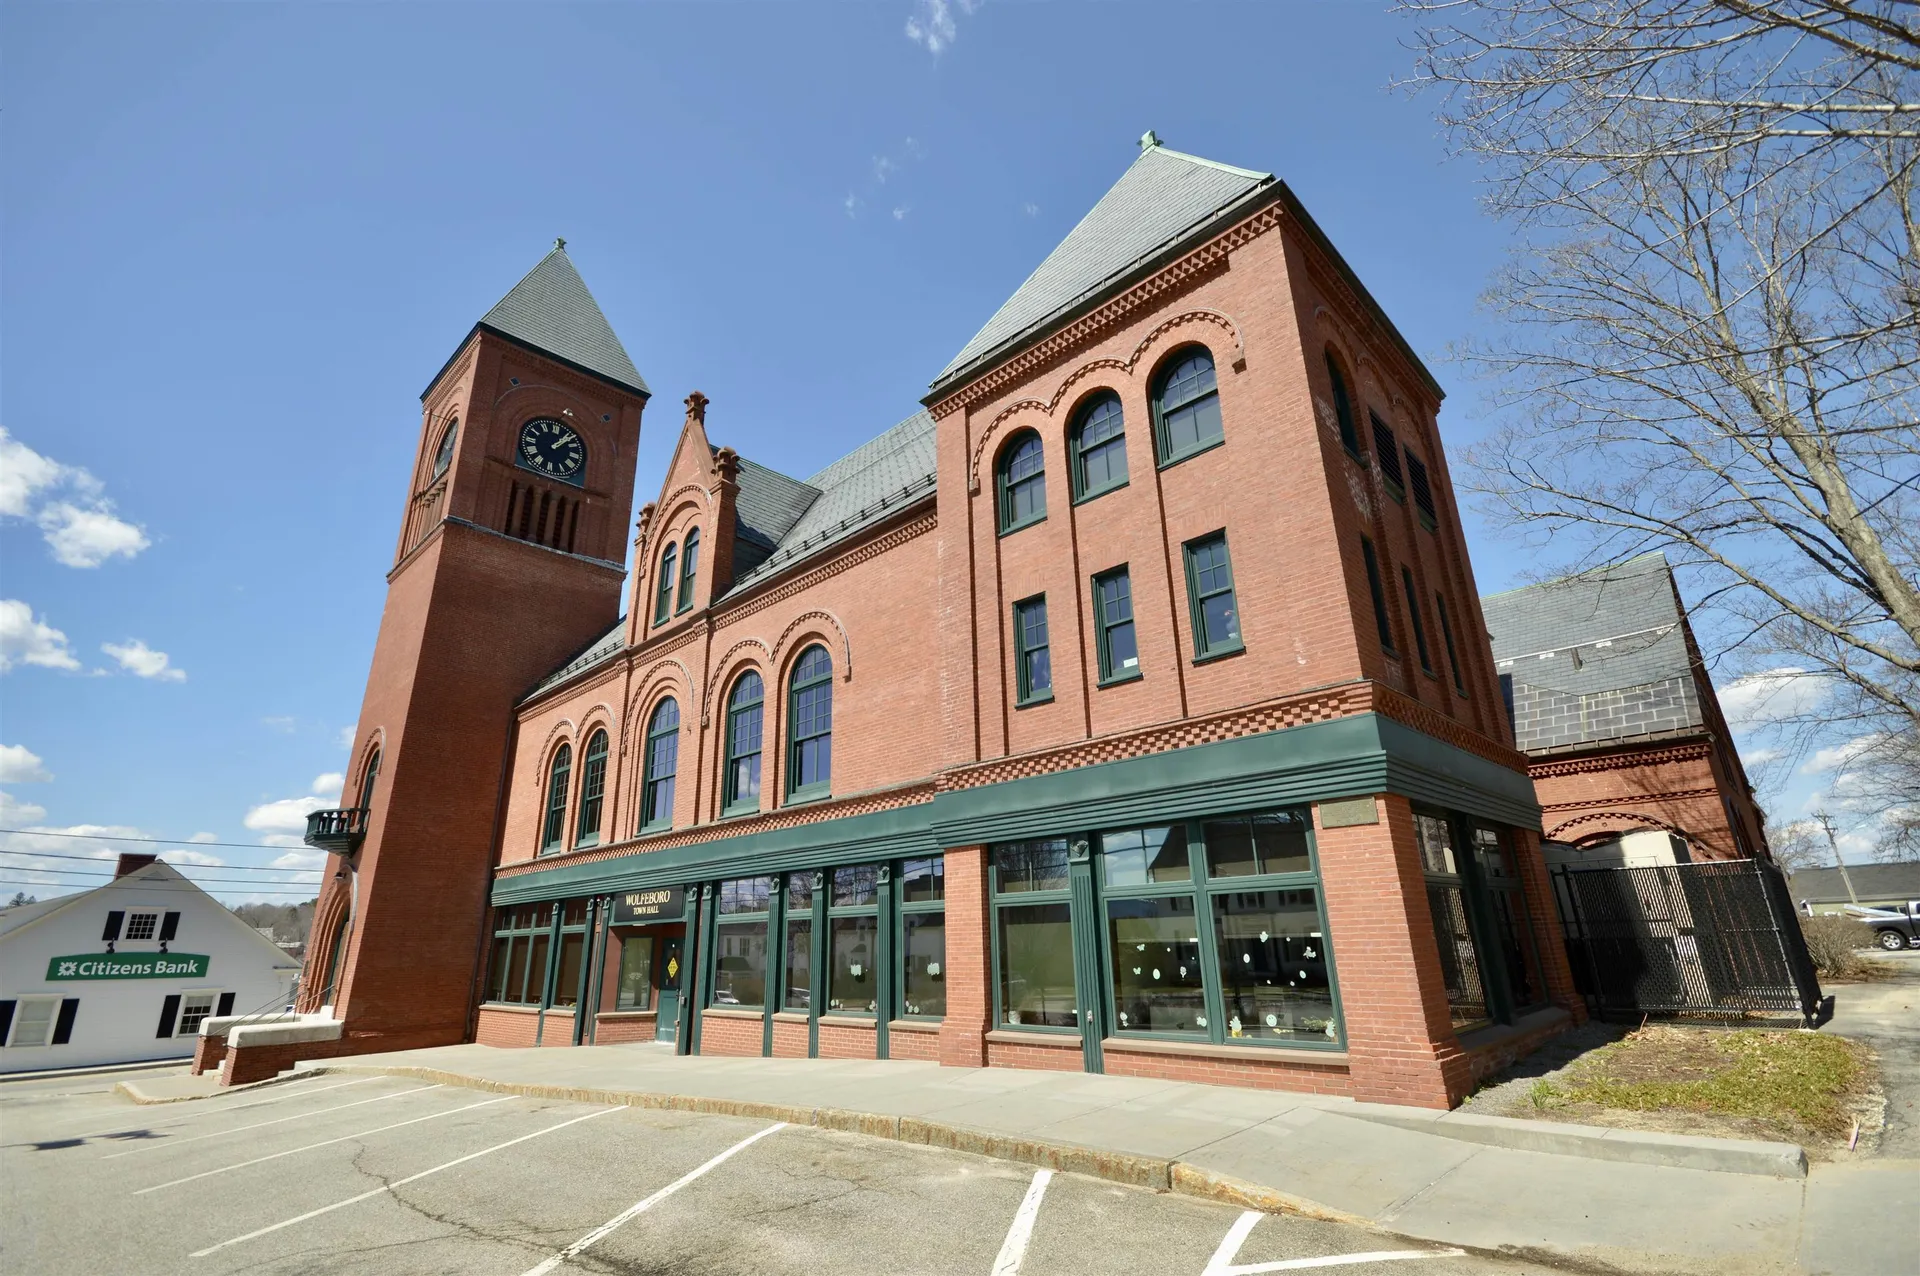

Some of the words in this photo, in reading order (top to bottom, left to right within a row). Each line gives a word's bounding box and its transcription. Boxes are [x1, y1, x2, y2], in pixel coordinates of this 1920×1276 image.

[625, 890, 671, 906] WOLFEBORO
[633, 906, 647, 915] TOWN
[647, 905, 659, 914] HALL
[78, 961, 151, 976] Citizens
[155, 959, 199, 974] Bank
